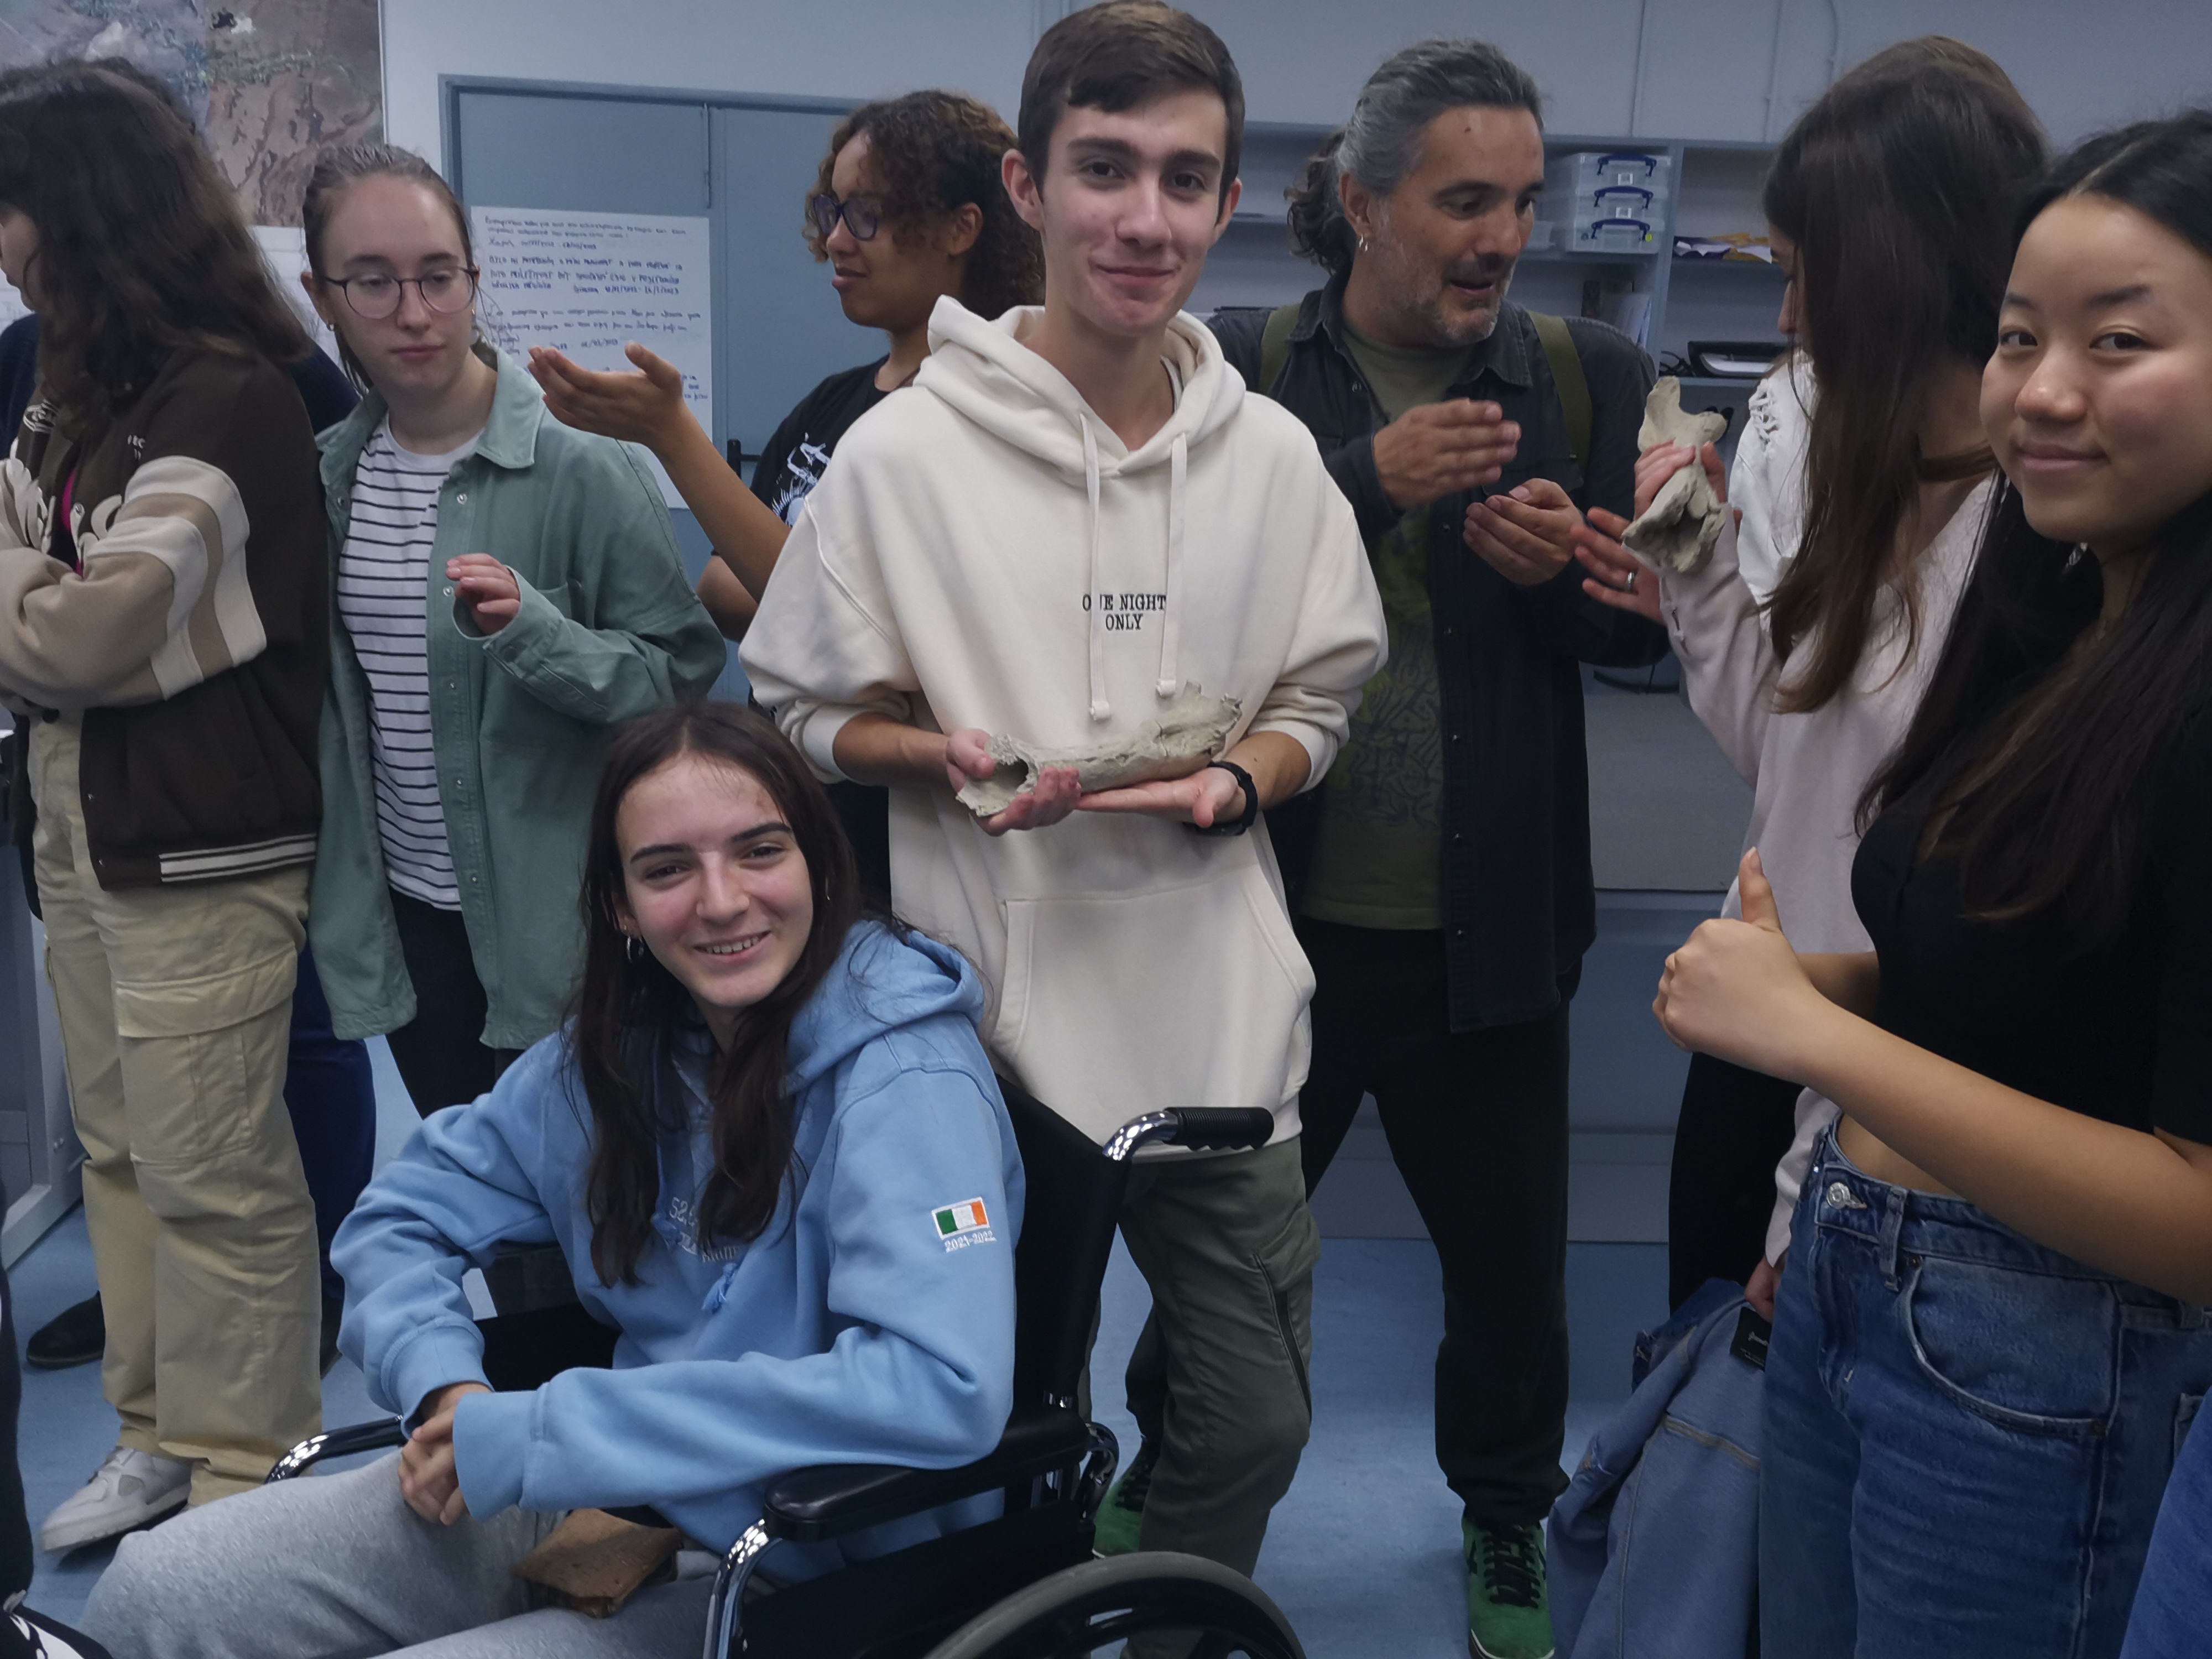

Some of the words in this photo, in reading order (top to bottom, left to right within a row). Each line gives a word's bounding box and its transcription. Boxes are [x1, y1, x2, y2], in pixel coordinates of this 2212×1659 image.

[1082, 593, 1113, 612] OE
[1119, 593, 1166, 611] NIGHT
[1105, 613, 1144, 631] ONLY
[945, 1230, 997, 1253] 2021-2022
